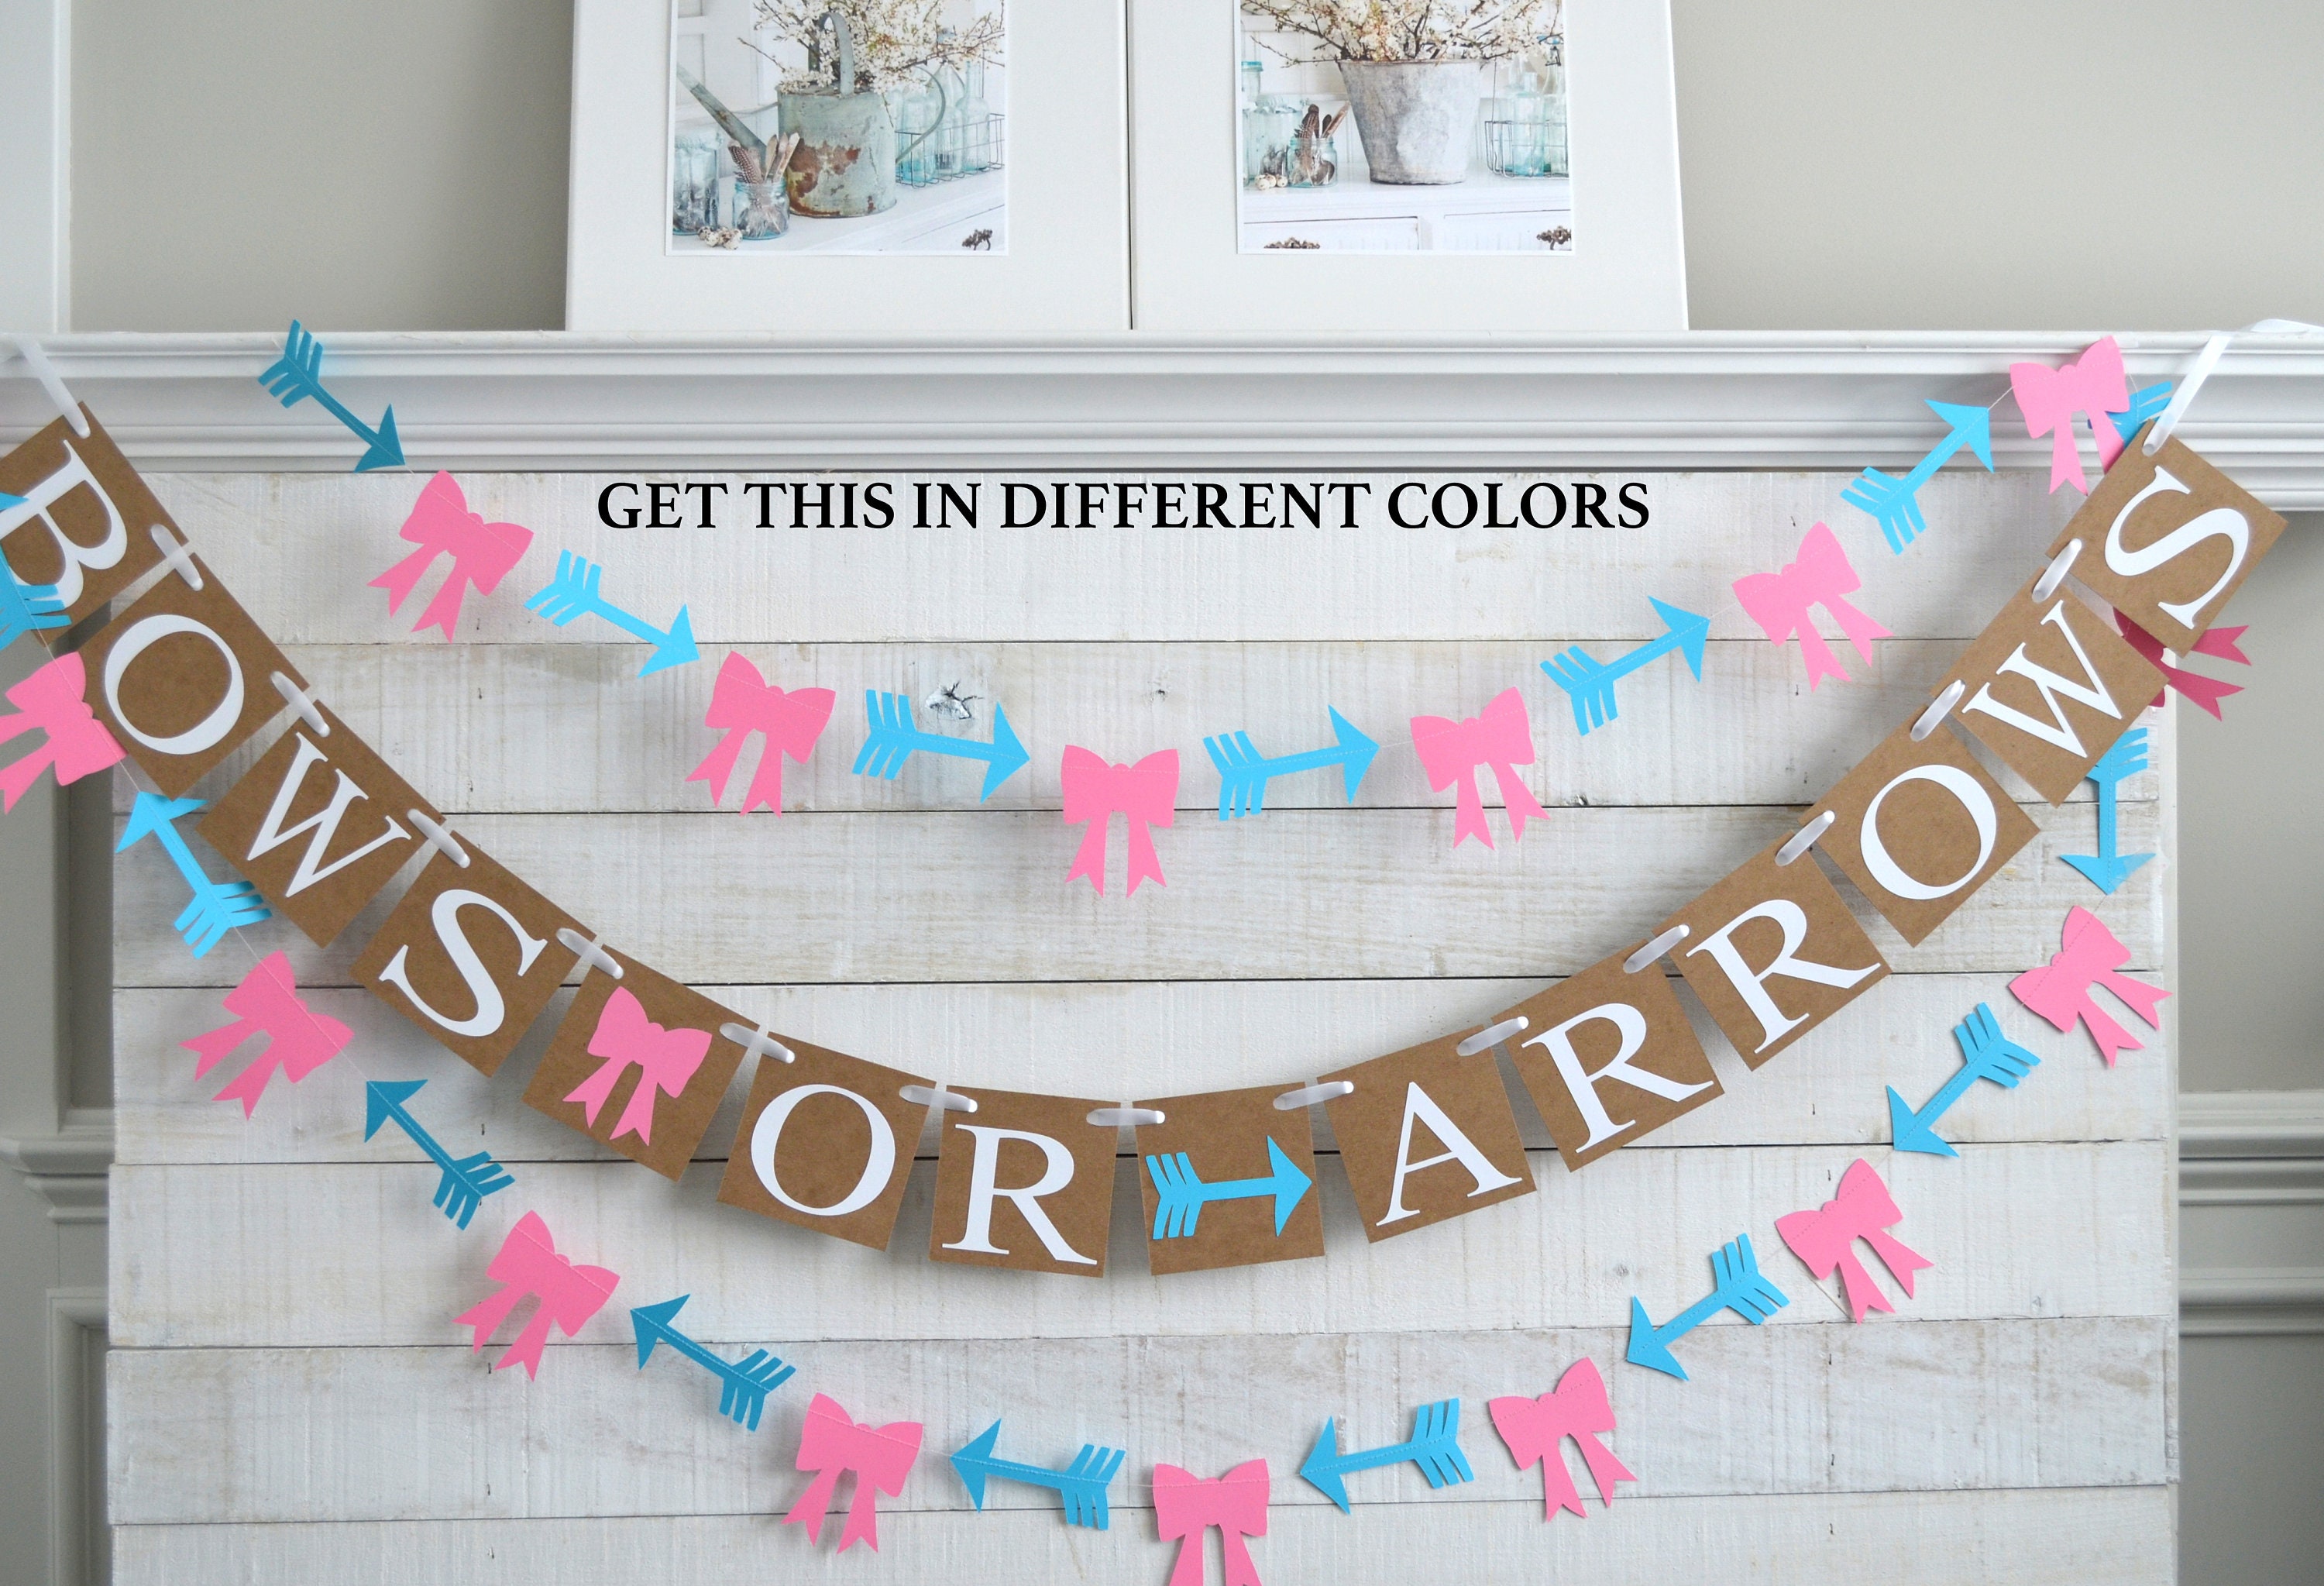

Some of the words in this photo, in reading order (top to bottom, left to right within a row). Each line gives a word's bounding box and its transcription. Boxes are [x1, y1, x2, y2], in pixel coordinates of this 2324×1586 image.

[0, 439, 548, 1037] BOWS
[750, 1083, 1098, 1265] OR
[1375, 465, 2250, 1226] ARROWS
